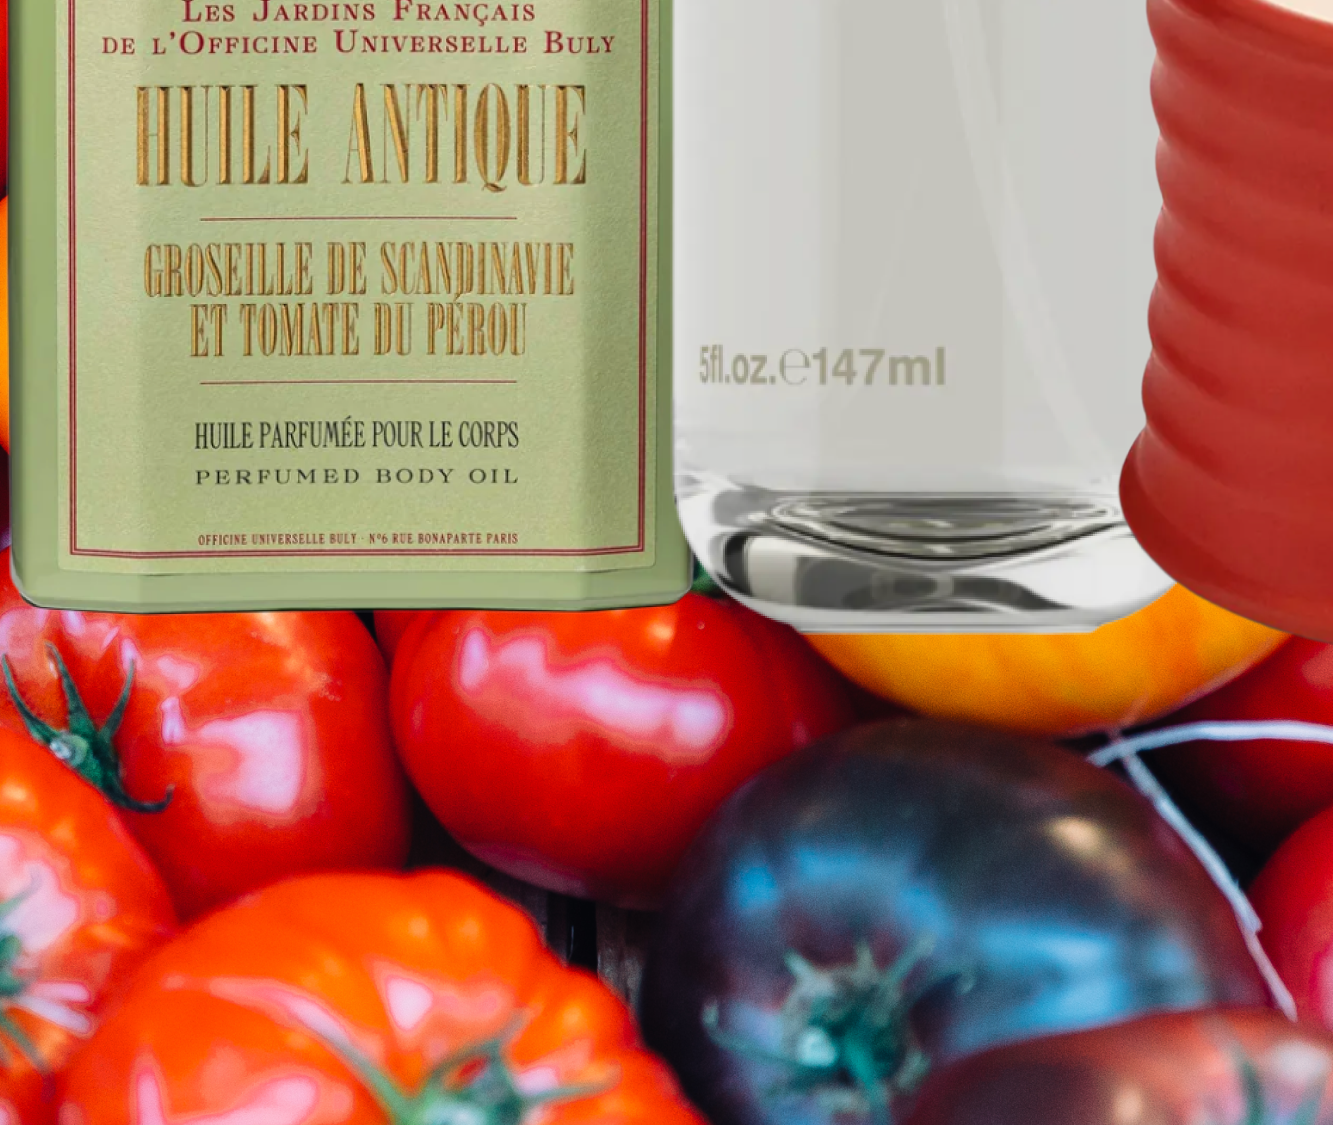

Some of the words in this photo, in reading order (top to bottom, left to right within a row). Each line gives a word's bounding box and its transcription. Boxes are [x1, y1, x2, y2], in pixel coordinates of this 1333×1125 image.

[103, 34, 136, 55] DE
[334, 29, 527, 55] UNIVERSELLE
[543, 29, 616, 55] BULY
[135, 84, 309, 187] HUILE
[343, 83, 587, 193] ANTIQUE
[143, 242, 313, 298] GROSEILLE
[326, 242, 367, 296] DE
[380, 241, 575, 299] SCANDINAVIE
[190, 303, 228, 357] ET
[239, 303, 360, 357] TOMATE
[373, 303, 413, 356] DU
[426, 292, 527, 356] PÉROU
[195, 422, 254, 449] HUILE
[259, 415, 366, 449] PARFUMÉE
[373, 422, 424, 448] POUR
[428, 422, 453, 448] LE
[458, 422, 519, 448] CORPS
[196, 469, 360, 485] PERFUMED
[375, 469, 454, 484] BODY
[469, 469, 518, 484] OIL
[198, 534, 247, 545] OFFICINE
[252, 534, 325, 545] UNIVERSELLE
[329, 534, 356, 545] BULY
[392, 533, 414, 544] RUE
[418, 533, 482, 544] BONAPARTE
[486, 533, 518, 544] PARIS
